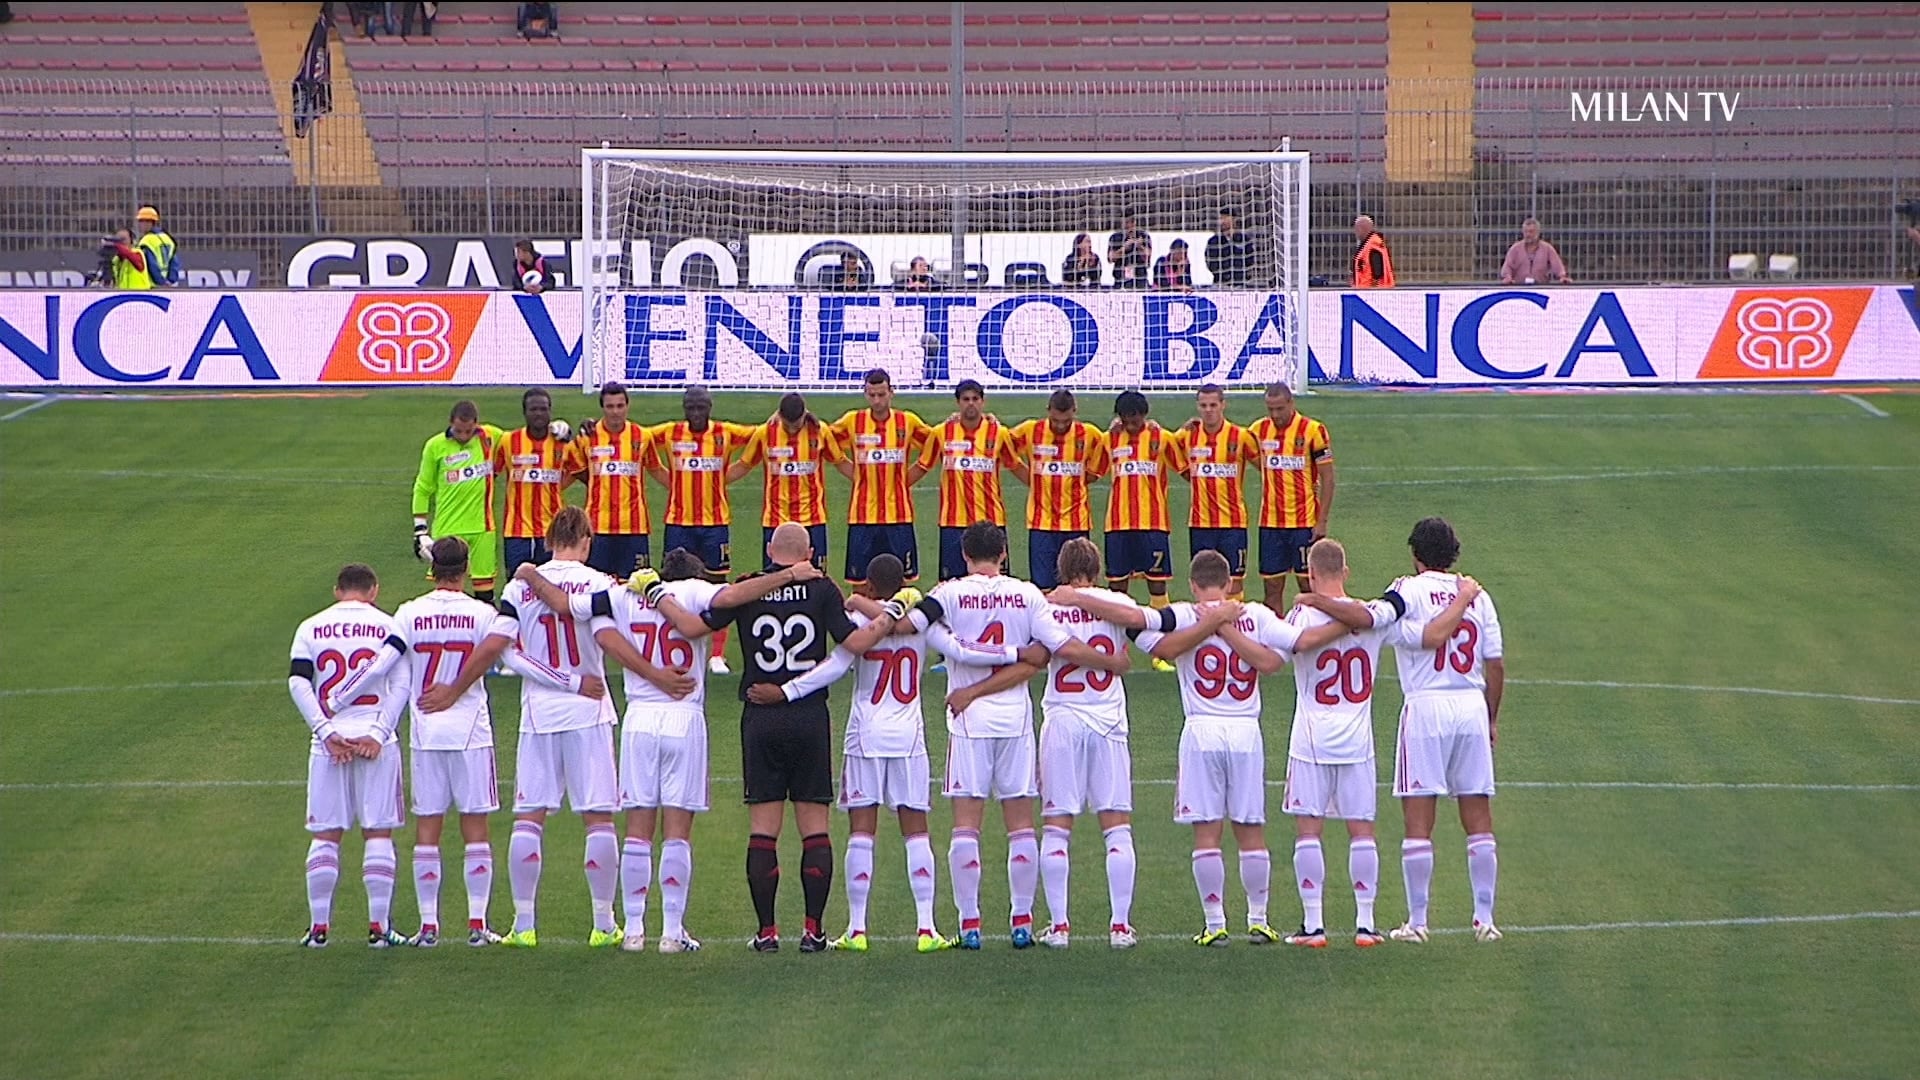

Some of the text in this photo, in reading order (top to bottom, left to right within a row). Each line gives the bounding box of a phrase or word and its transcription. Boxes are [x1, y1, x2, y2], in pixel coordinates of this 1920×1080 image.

[511, 290, 1658, 382] VENETO BANCA
[313, 621, 386, 640] NOCERINO
[414, 614, 475, 632] ANTONINI
[539, 613, 580, 669] 11
[630, 621, 694, 675] 76
[751, 613, 817, 673] 32
[413, 640, 475, 695] 77
[863, 646, 918, 705] 70
[1194, 644, 1256, 701] 99
[1315, 647, 1372, 705] 20
